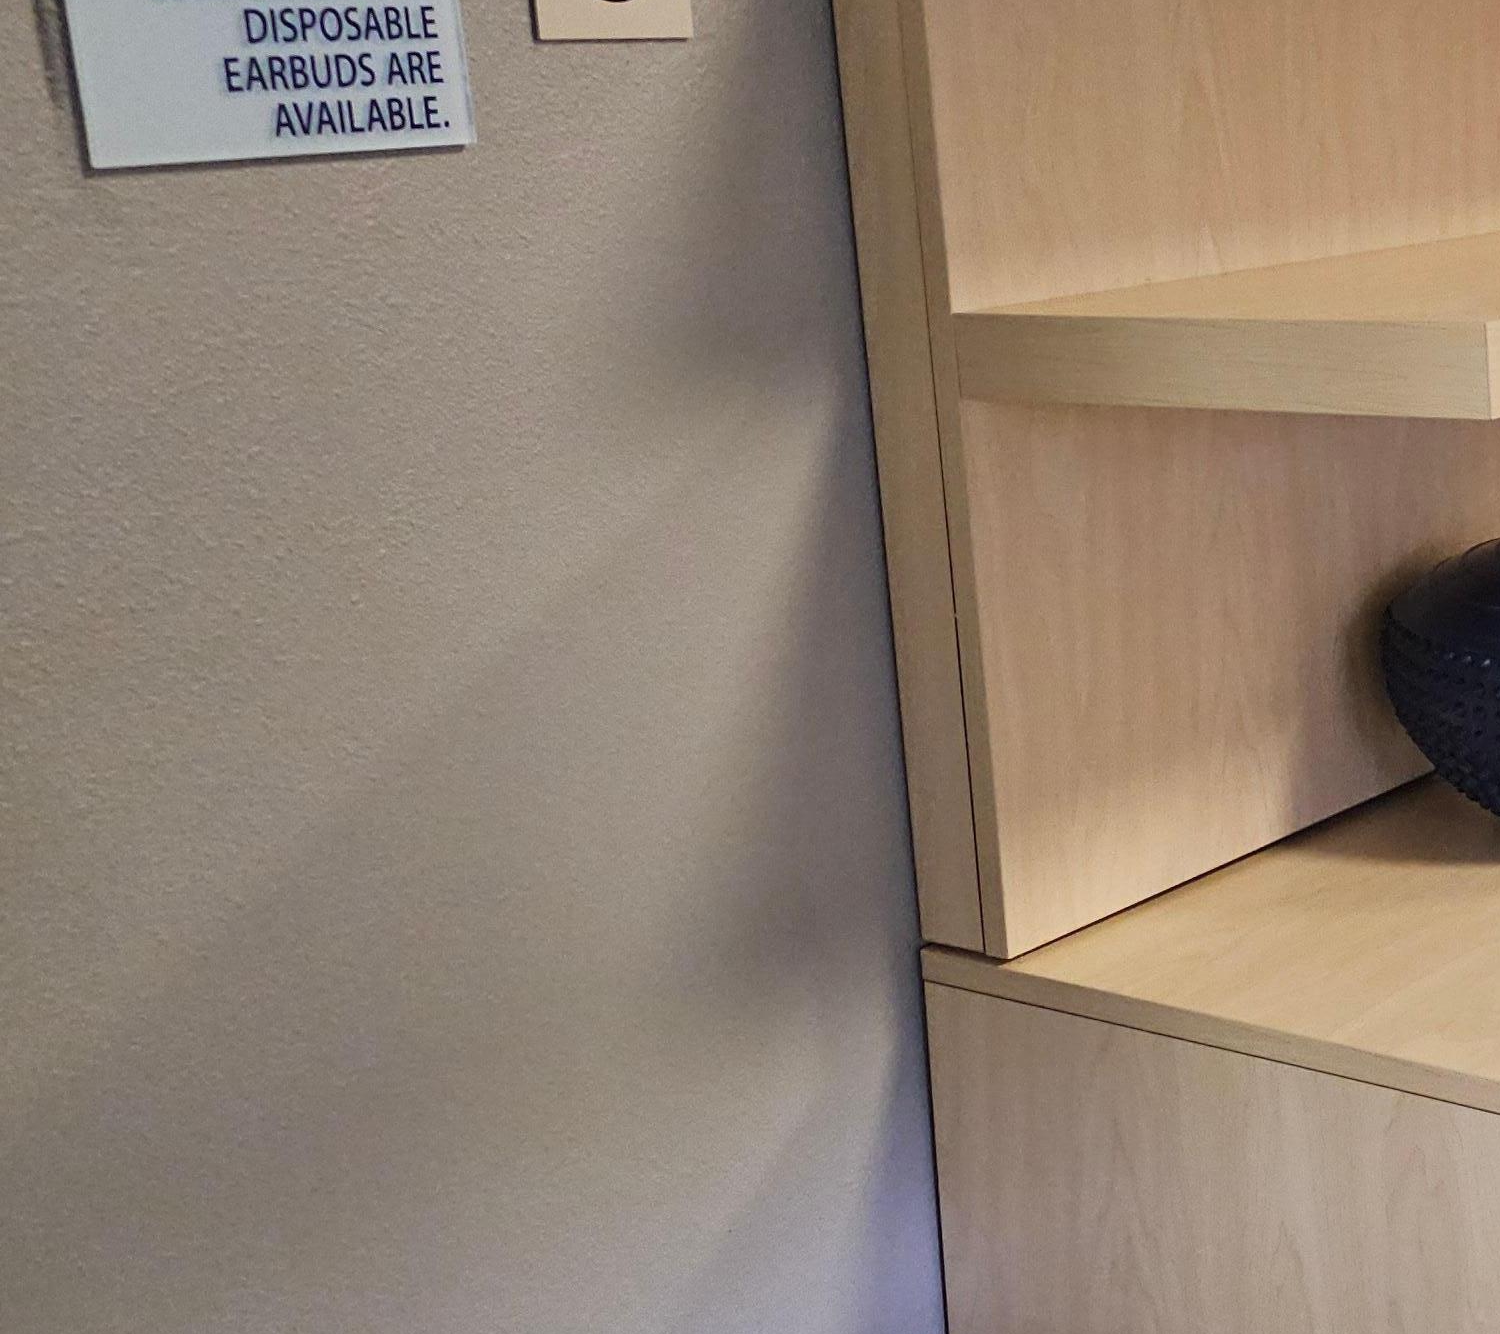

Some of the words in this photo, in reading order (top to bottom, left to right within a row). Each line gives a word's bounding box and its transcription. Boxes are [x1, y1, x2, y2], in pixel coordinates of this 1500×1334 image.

[243, 5, 439, 44] DISPOSABLE
[223, 52, 376, 92] EARBUDS
[387, 51, 444, 86] ARE
[276, 96, 450, 138] AVAILABLE.
